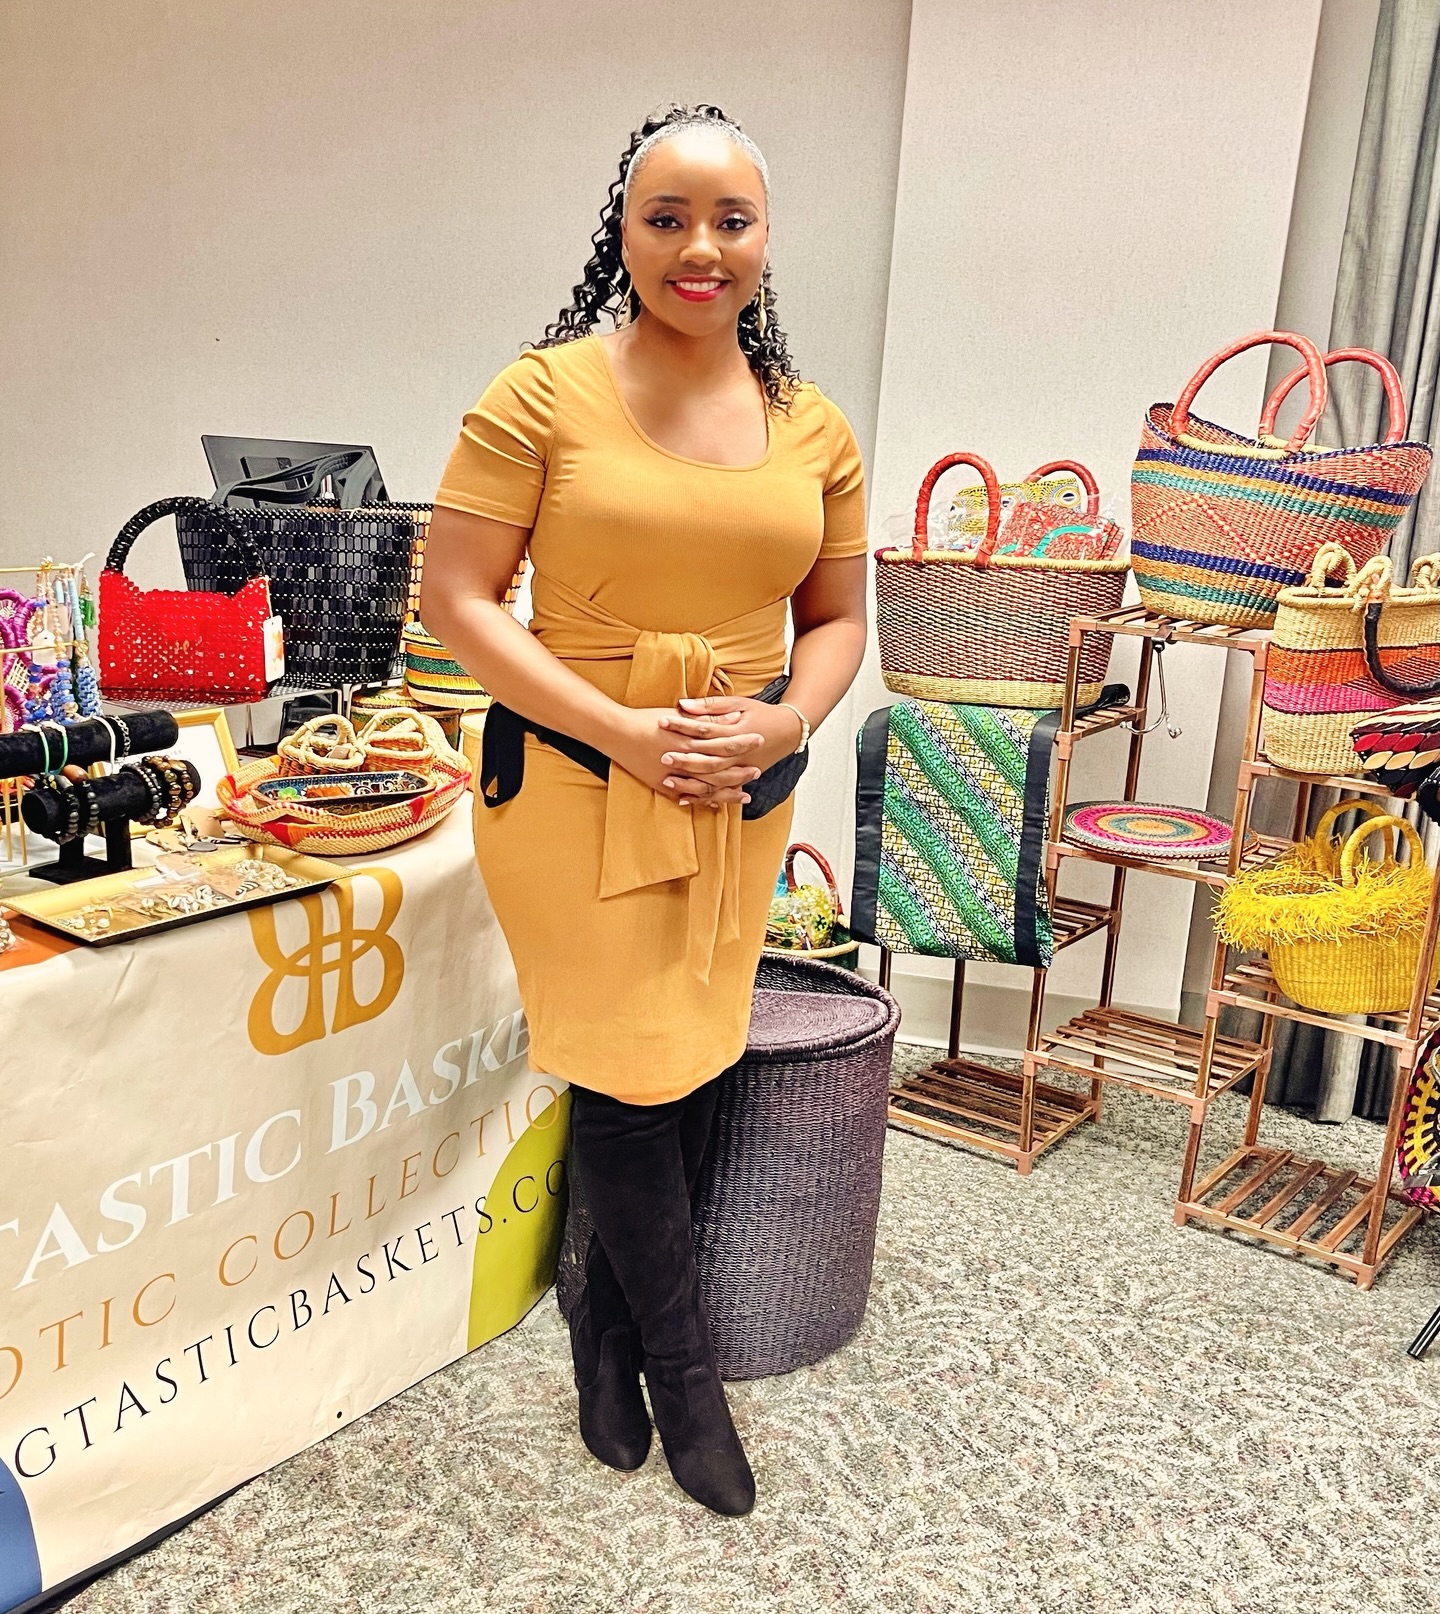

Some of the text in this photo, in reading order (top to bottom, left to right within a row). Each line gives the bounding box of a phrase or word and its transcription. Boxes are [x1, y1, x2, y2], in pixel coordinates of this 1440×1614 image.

[0, 1110, 301, 1291] ASTIC
[218, 1084, 560, 1287] COLLECTIO
[0, 1159, 565, 1496] GTASTICBASKETS.CO
